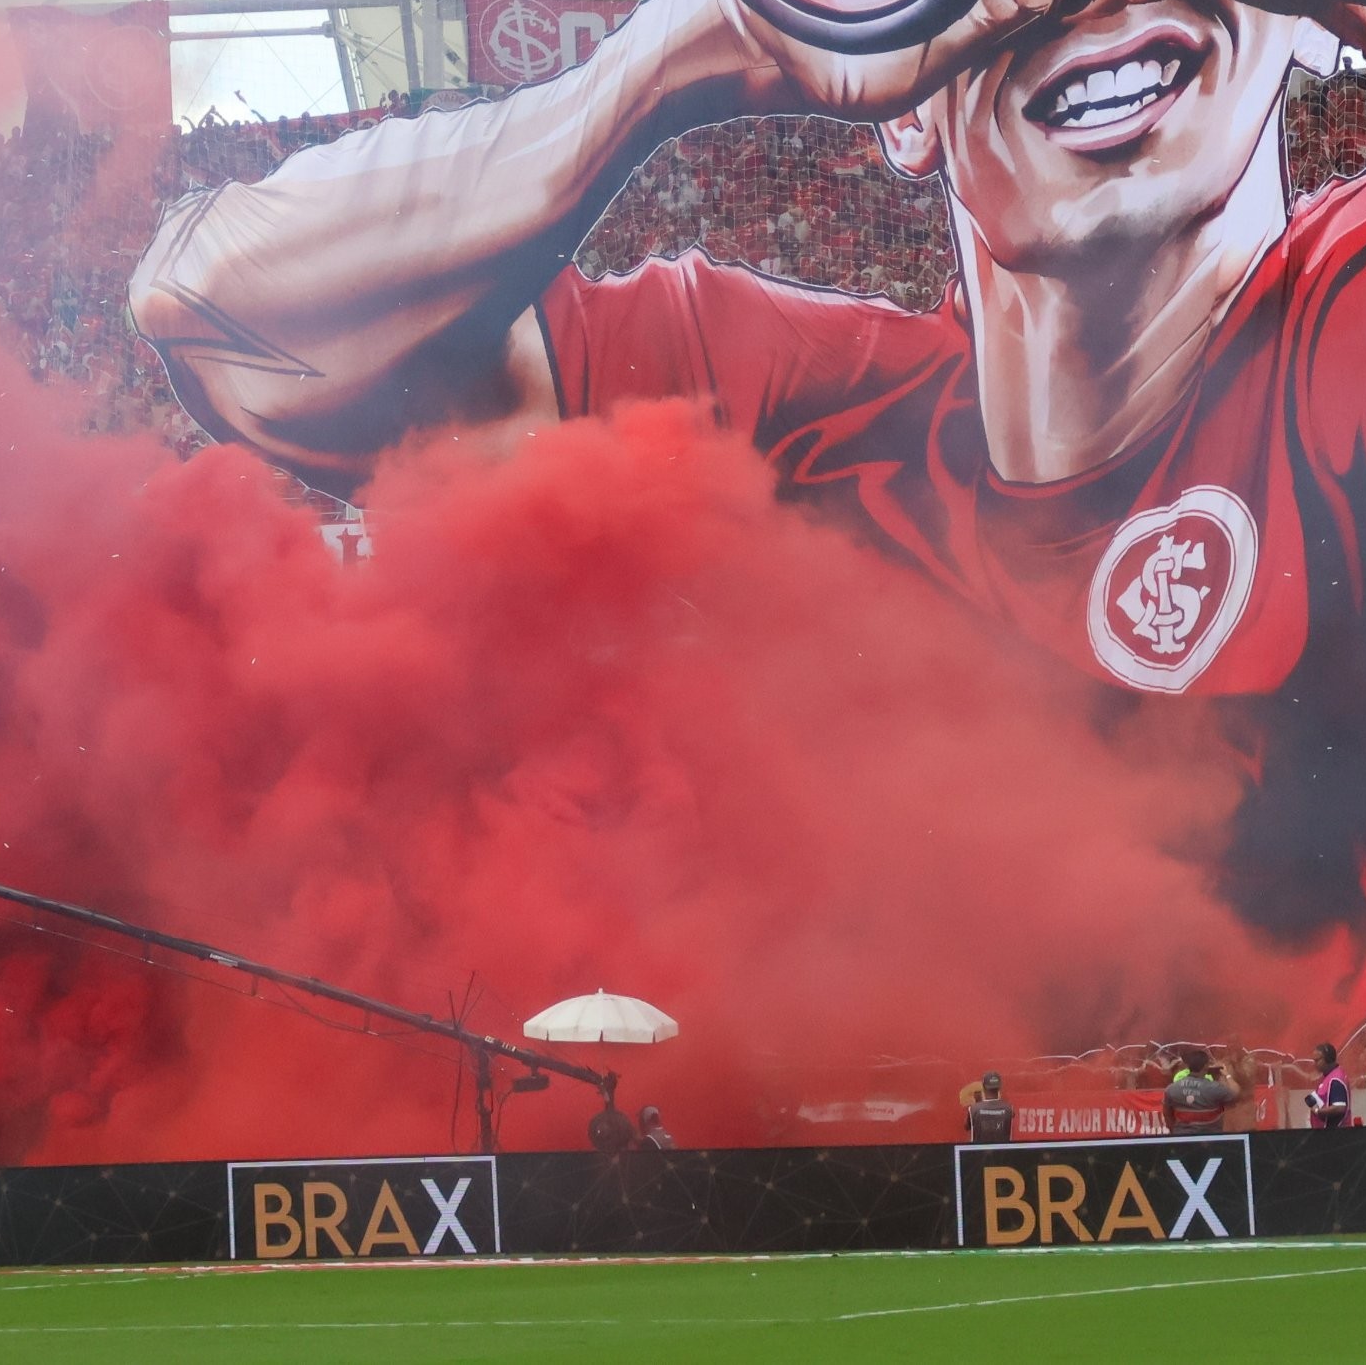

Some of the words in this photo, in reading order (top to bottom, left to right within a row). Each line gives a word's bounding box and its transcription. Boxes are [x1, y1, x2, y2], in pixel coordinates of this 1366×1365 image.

[1019, 1107, 1055, 1132] ESTE
[1059, 1108, 1101, 1133] AMOR
[253, 1177, 477, 1259] BRAX
[983, 1157, 1230, 1245] BRAX
